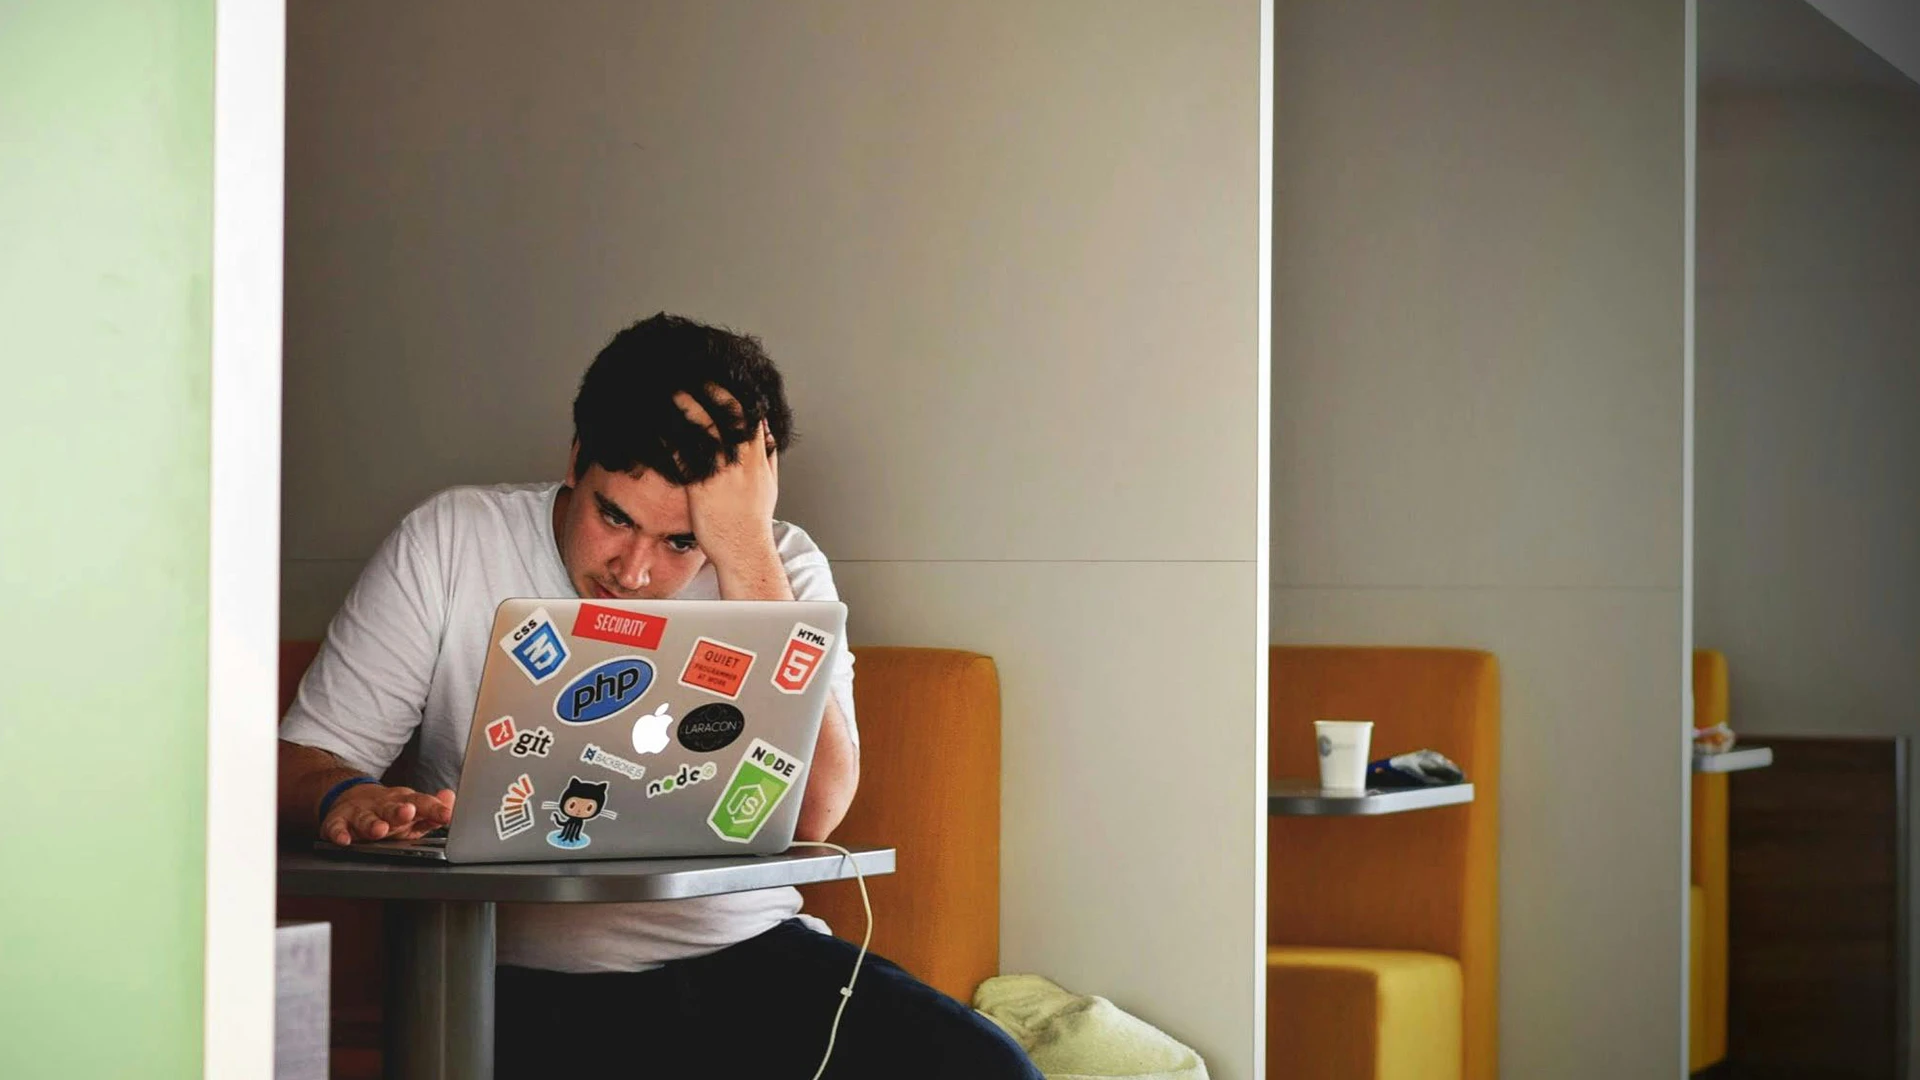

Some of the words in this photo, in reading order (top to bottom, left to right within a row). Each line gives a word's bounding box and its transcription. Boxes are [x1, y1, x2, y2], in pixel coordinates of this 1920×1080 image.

[513, 619, 538, 641] CSS
[594, 613, 647, 638] SECURITY
[797, 628, 826, 647] HTML
[704, 650, 740, 668] QUIET
[782, 649, 815, 682] 5
[694, 663, 738, 681] PROGRAMMER
[573, 668, 639, 718] php
[685, 721, 737, 735] LARACON
[513, 730, 551, 755] git
[752, 747, 796, 777] NODE
